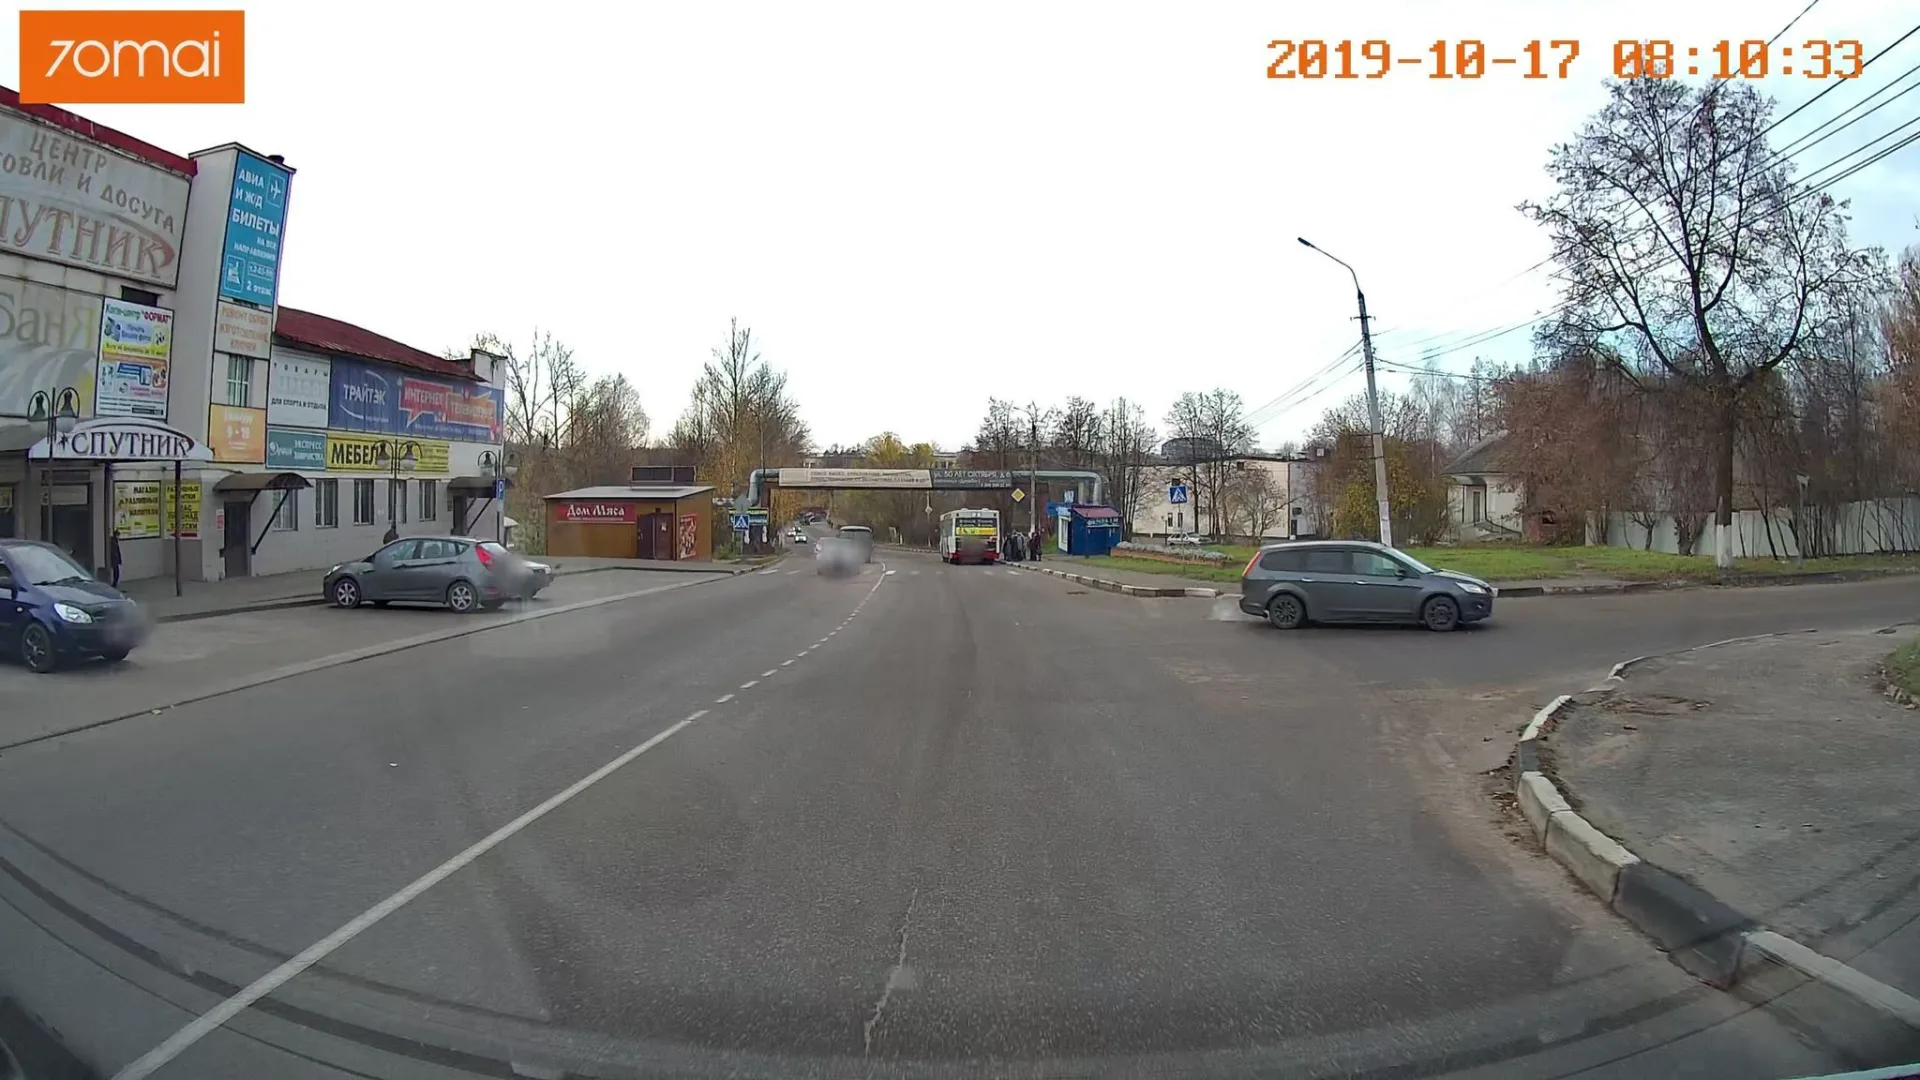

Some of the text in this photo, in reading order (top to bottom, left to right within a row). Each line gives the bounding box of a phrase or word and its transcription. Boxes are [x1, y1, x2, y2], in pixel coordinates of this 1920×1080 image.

[29, 131, 107, 174] ЦЕНТР
[238, 168, 265, 189] АВИА
[0, 153, 174, 235] ОВЛИ И ДОСУГА
[235, 187, 244, 200] И
[232, 207, 280, 236] БИЛЕТЫ
[256, 236, 266, 247] НА
[246, 280, 252, 291] 2
[343, 383, 386, 406] ТРАЙТЭК
[71, 430, 189, 458] СПУТНИК
[567, 504, 625, 517] Дом Мяса
